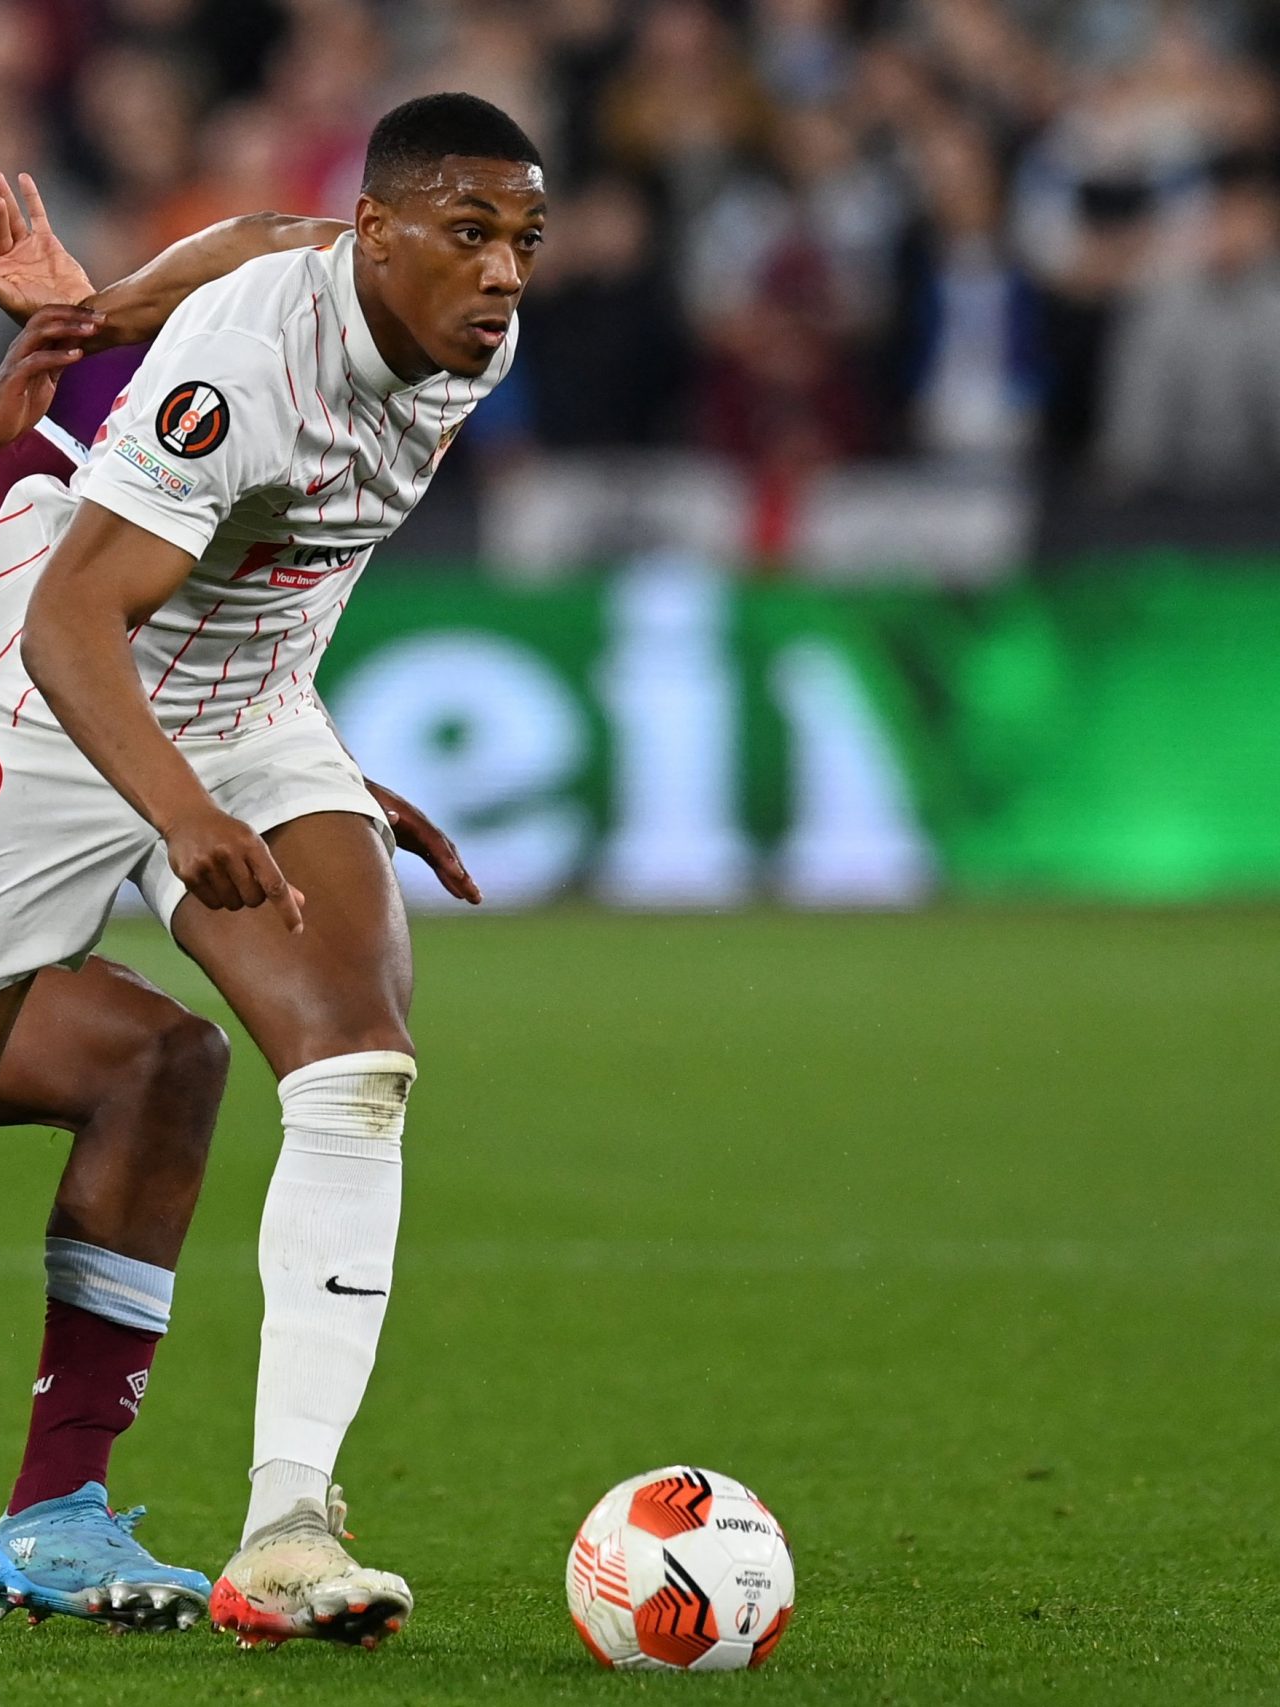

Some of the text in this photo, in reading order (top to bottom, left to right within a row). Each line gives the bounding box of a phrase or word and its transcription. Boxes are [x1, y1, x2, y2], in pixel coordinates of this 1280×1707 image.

[179, 409, 201, 433] 6
[117, 439, 192, 496] FOUNDATION
[276, 572, 321, 586] Your Inve
[716, 1518, 771, 1535] molten
[735, 1576, 772, 1590] EUROPA
